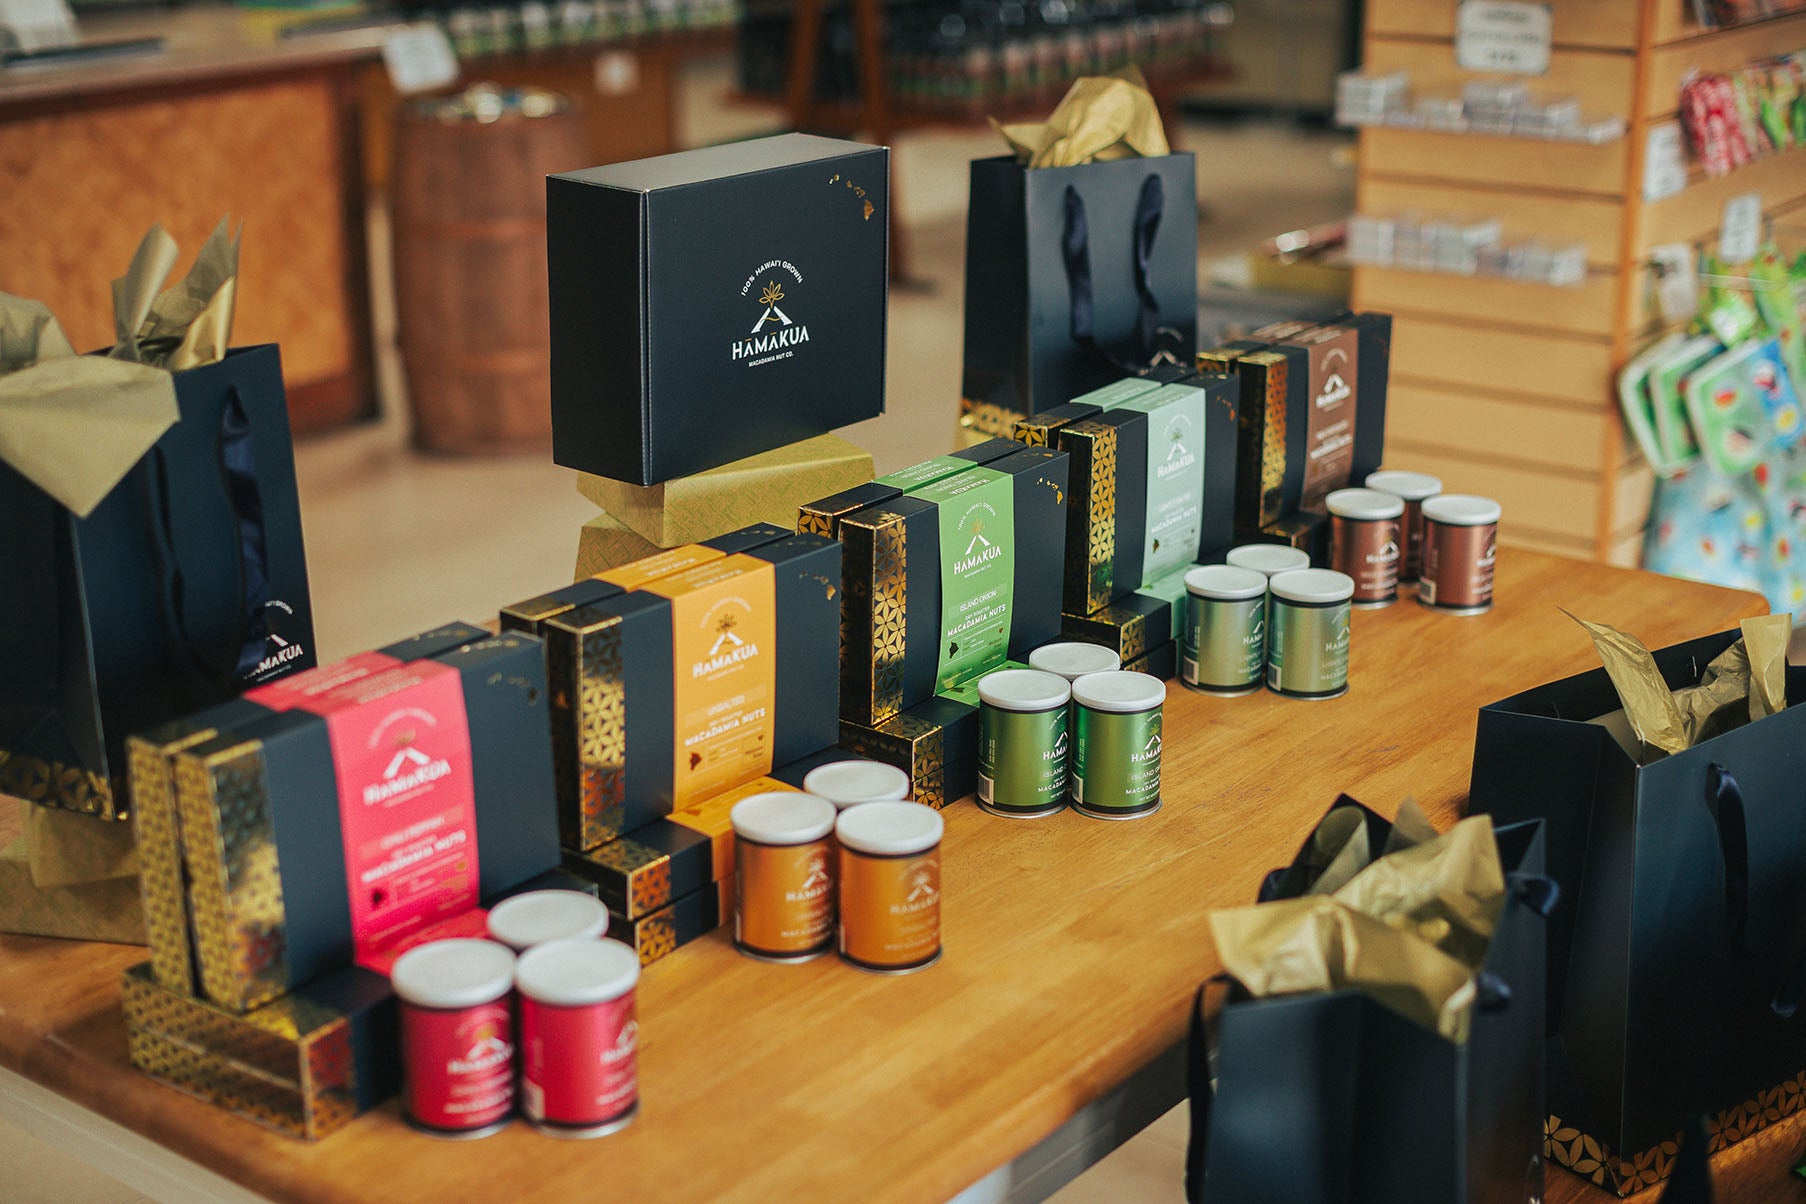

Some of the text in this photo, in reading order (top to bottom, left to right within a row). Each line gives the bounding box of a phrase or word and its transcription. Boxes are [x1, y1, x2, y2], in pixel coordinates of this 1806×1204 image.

[741, 275, 755, 296] 100%
[782, 261, 803, 283] GROWN
[748, 355, 776, 367] MACADAMIA
[776, 352, 785, 360] NUT
[960, 589, 997, 613] ISLAND ONION
[947, 614, 987, 637] MACADAMIA
[989, 603, 1006, 617] NUTS
[684, 719, 740, 746] MACADAMIA
[742, 708, 766, 723] NUTS
